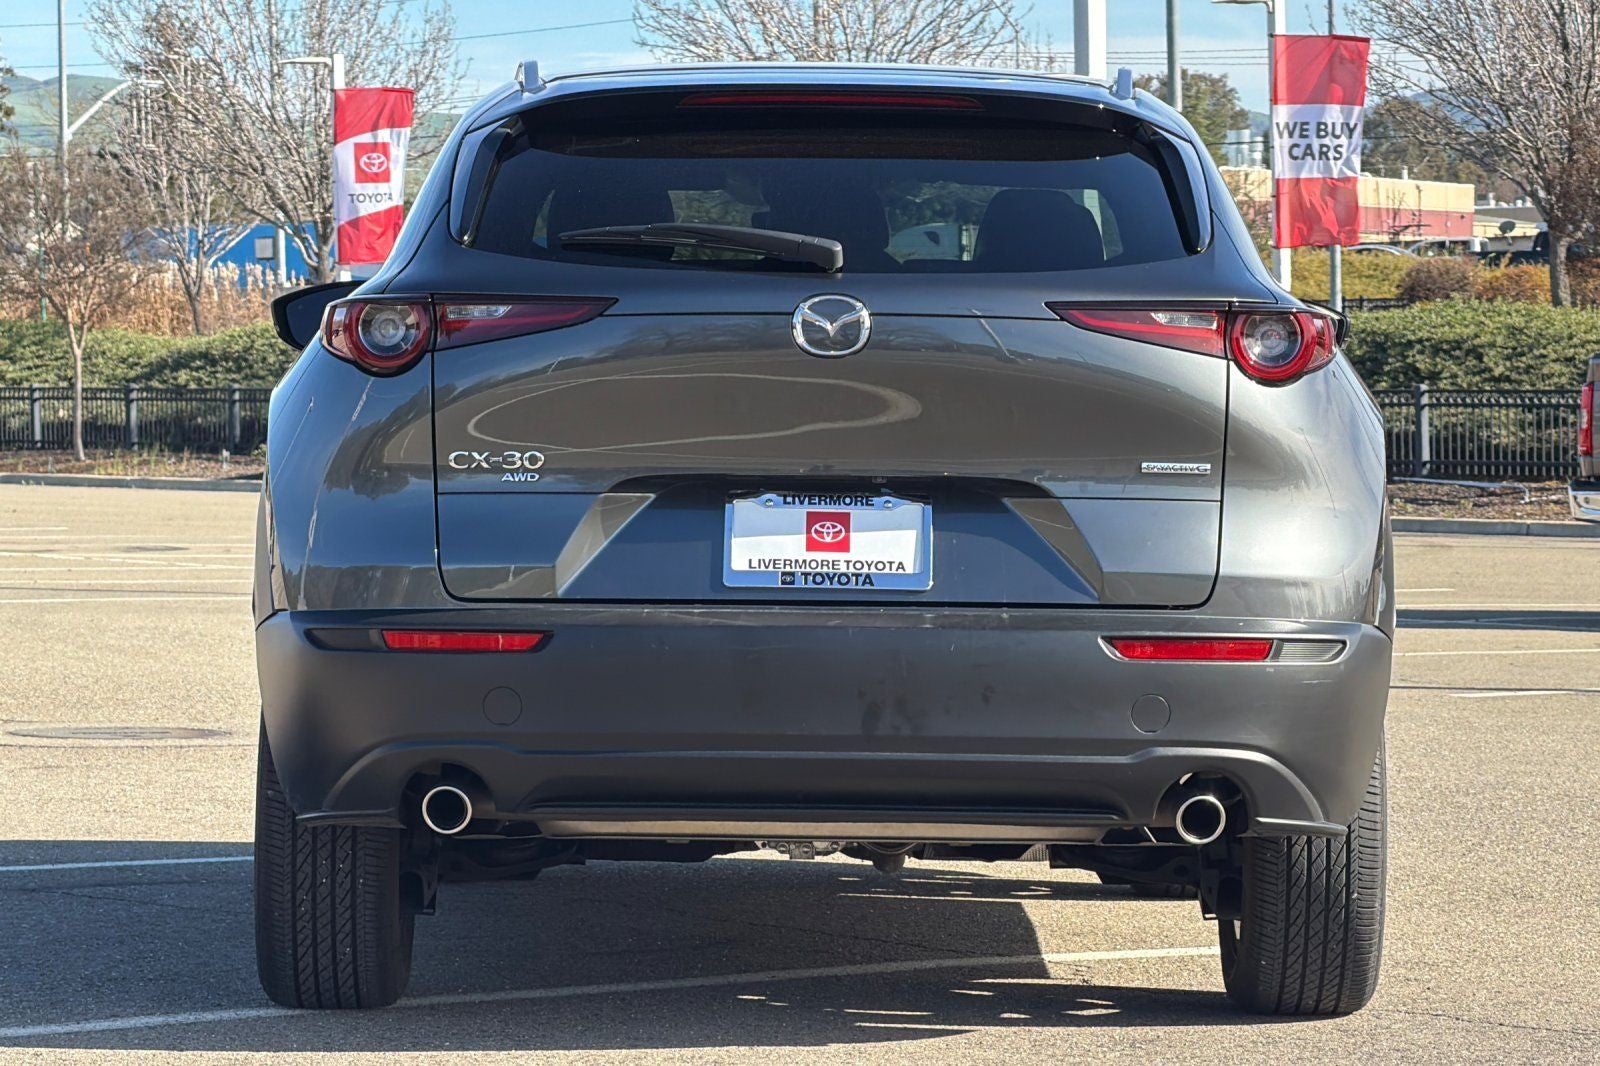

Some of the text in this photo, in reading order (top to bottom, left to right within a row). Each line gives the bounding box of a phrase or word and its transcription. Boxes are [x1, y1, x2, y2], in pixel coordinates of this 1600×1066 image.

[1276, 121, 1358, 139] WE BUY
[1288, 143, 1344, 161] CARS
[348, 193, 393, 204] TOYOTA
[448, 450, 545, 469] CX-30
[501, 472, 540, 482] AWD
[782, 494, 875, 507] LIVERMORE
[748, 558, 906, 572] LIVERMORE TOYOTA
[801, 572, 875, 587] TOYOTA
